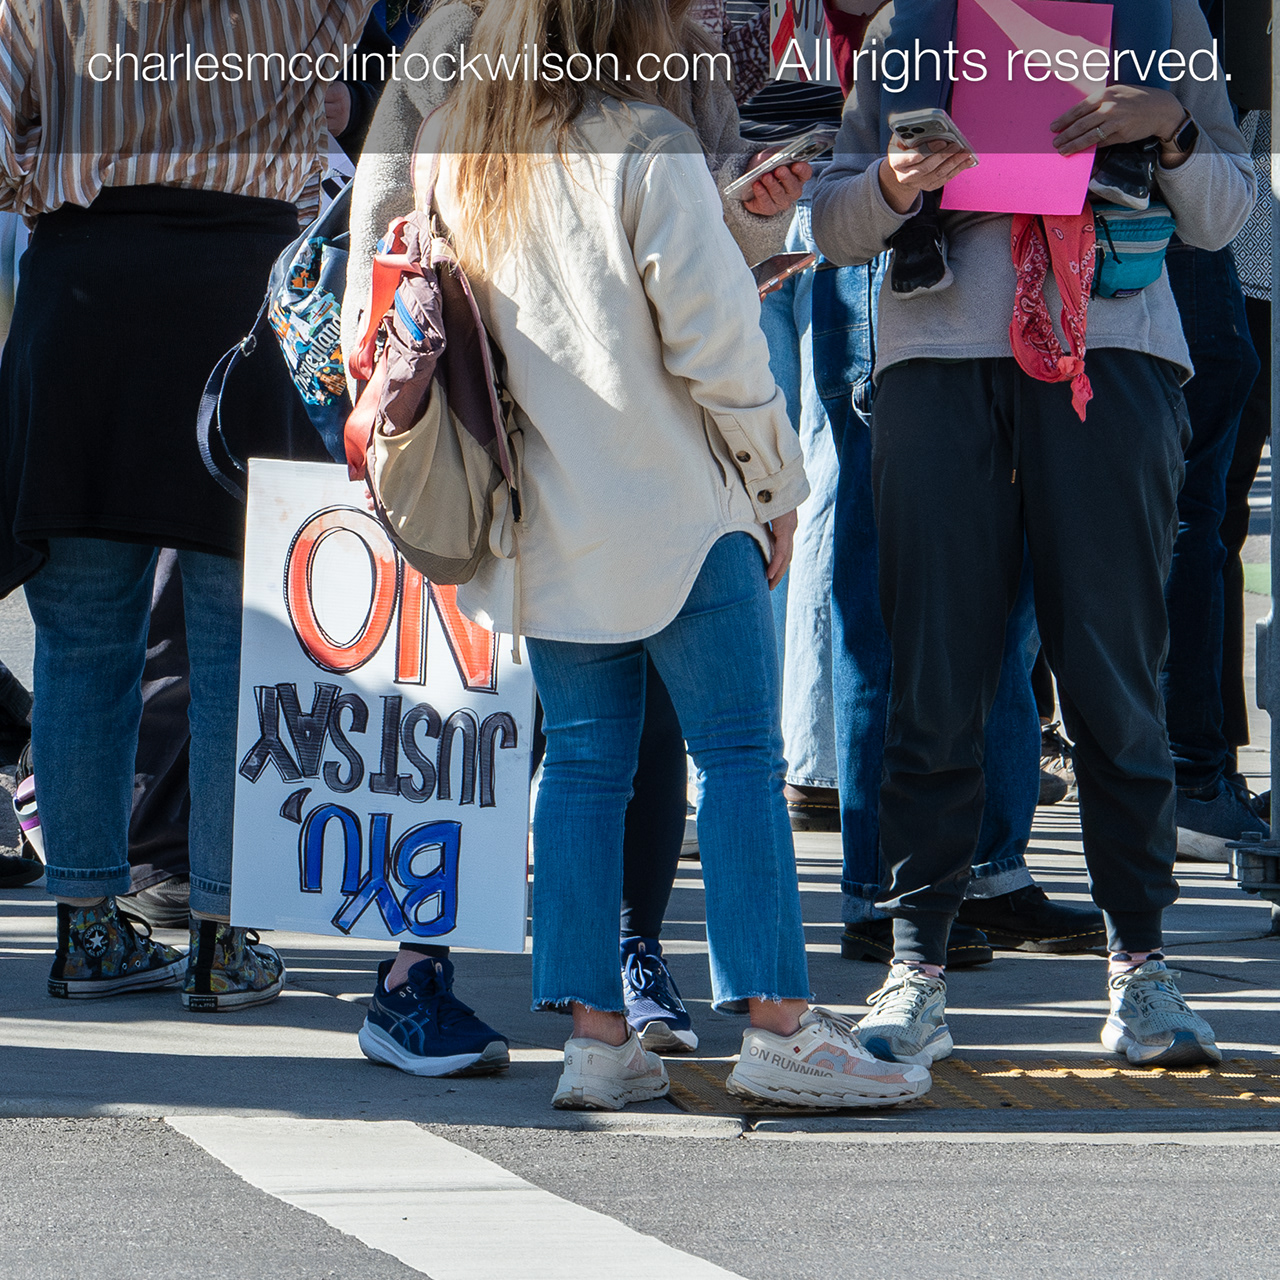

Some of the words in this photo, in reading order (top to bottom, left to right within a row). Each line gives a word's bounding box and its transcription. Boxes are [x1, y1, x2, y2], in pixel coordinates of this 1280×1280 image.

[284, 503, 500, 694] NO
[239, 683, 369, 794] SAY
[370, 695, 518, 808] JUST
[280, 787, 463, 937] BYU,
[748, 1045, 771, 1061] ON
